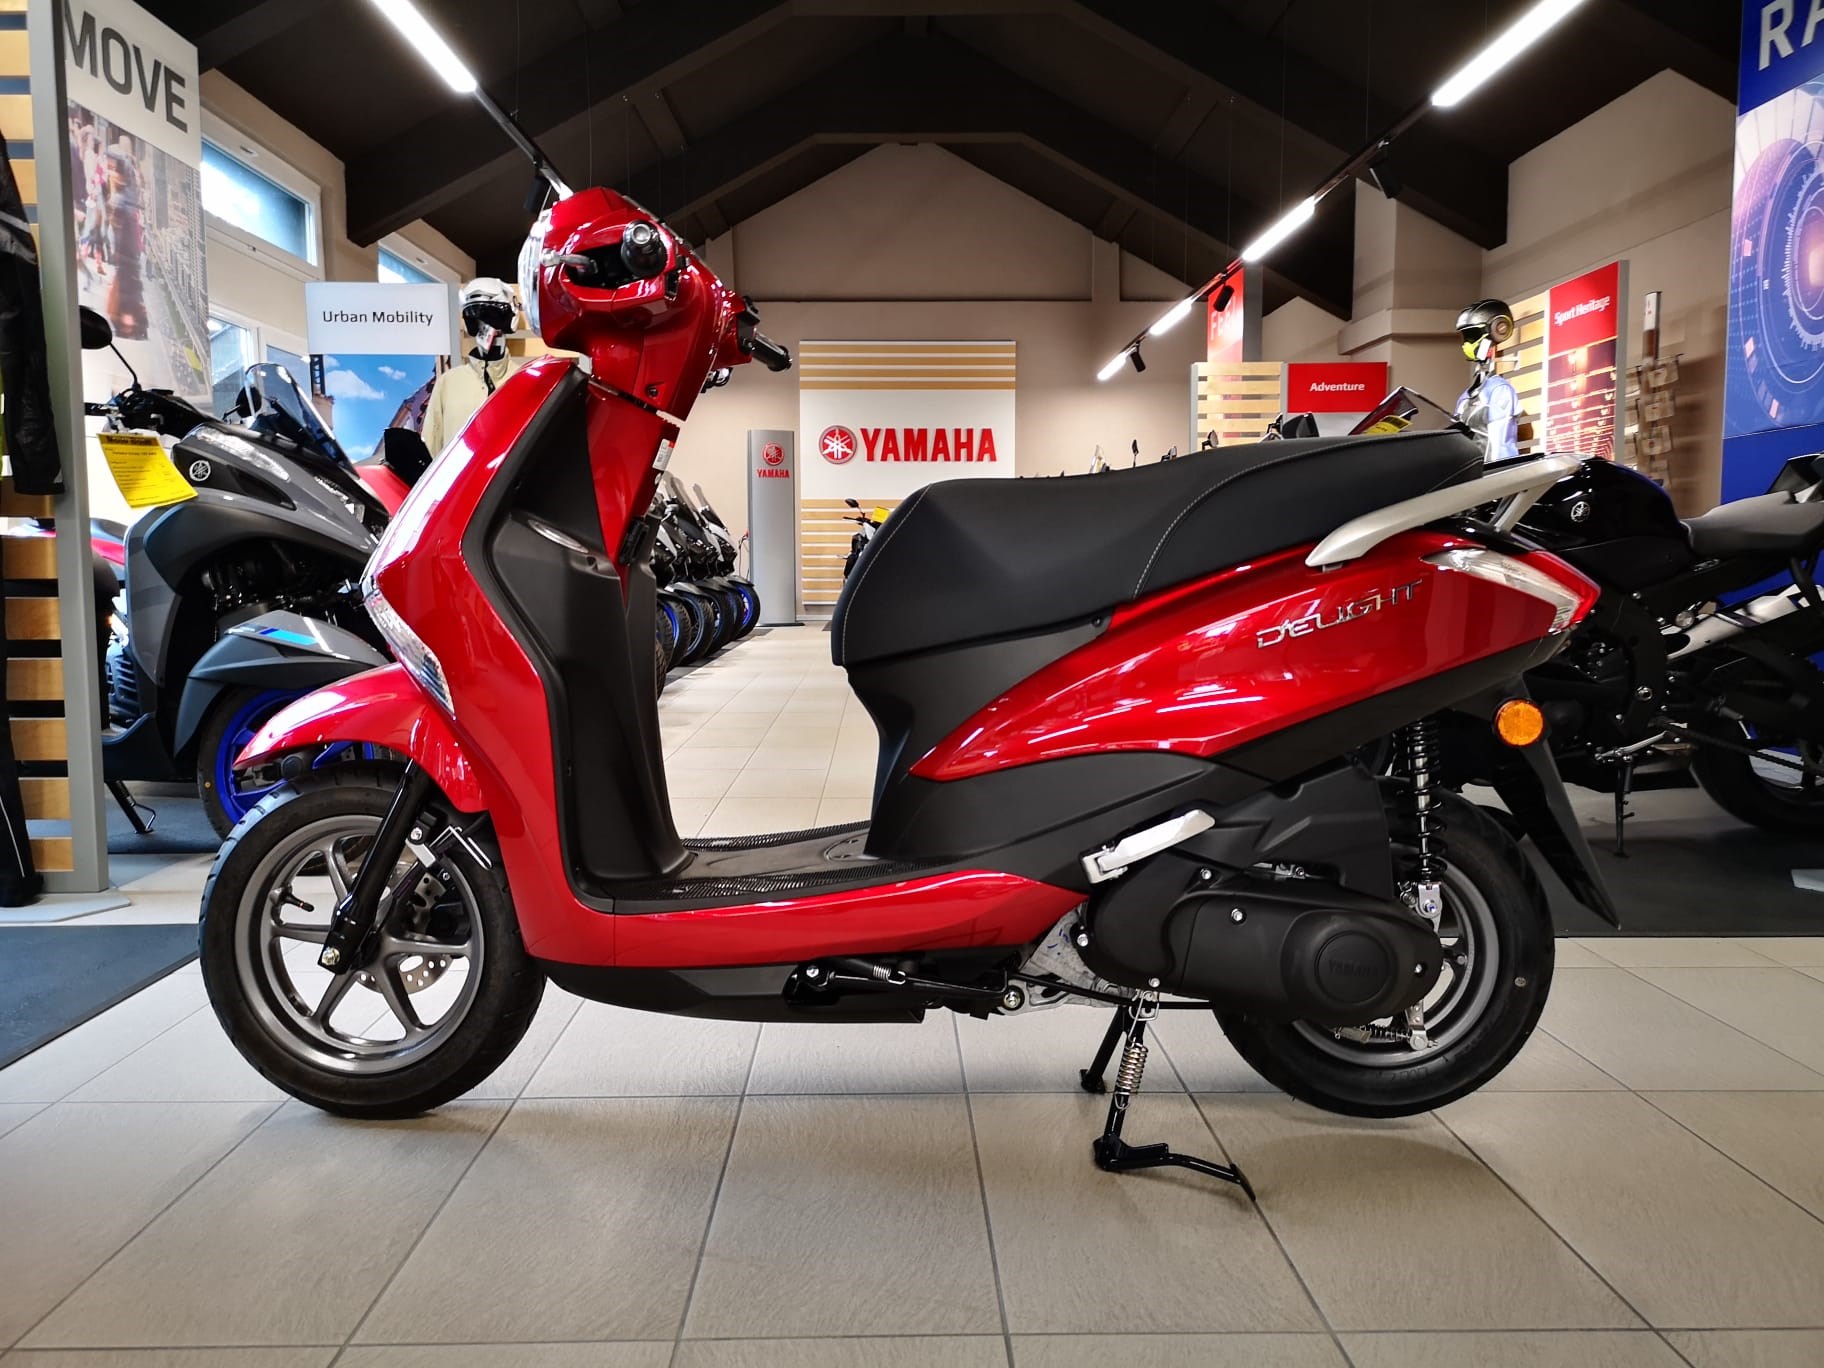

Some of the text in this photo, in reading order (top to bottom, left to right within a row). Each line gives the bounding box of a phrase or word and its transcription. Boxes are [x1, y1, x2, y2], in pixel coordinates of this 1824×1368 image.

[64, 0, 188, 133] MOVE
[322, 310, 434, 327] Urban Mobility
[1309, 382, 1366, 392] Adventure
[860, 427, 998, 462] YAMAHA
[756, 468, 790, 479] YAMAHA
